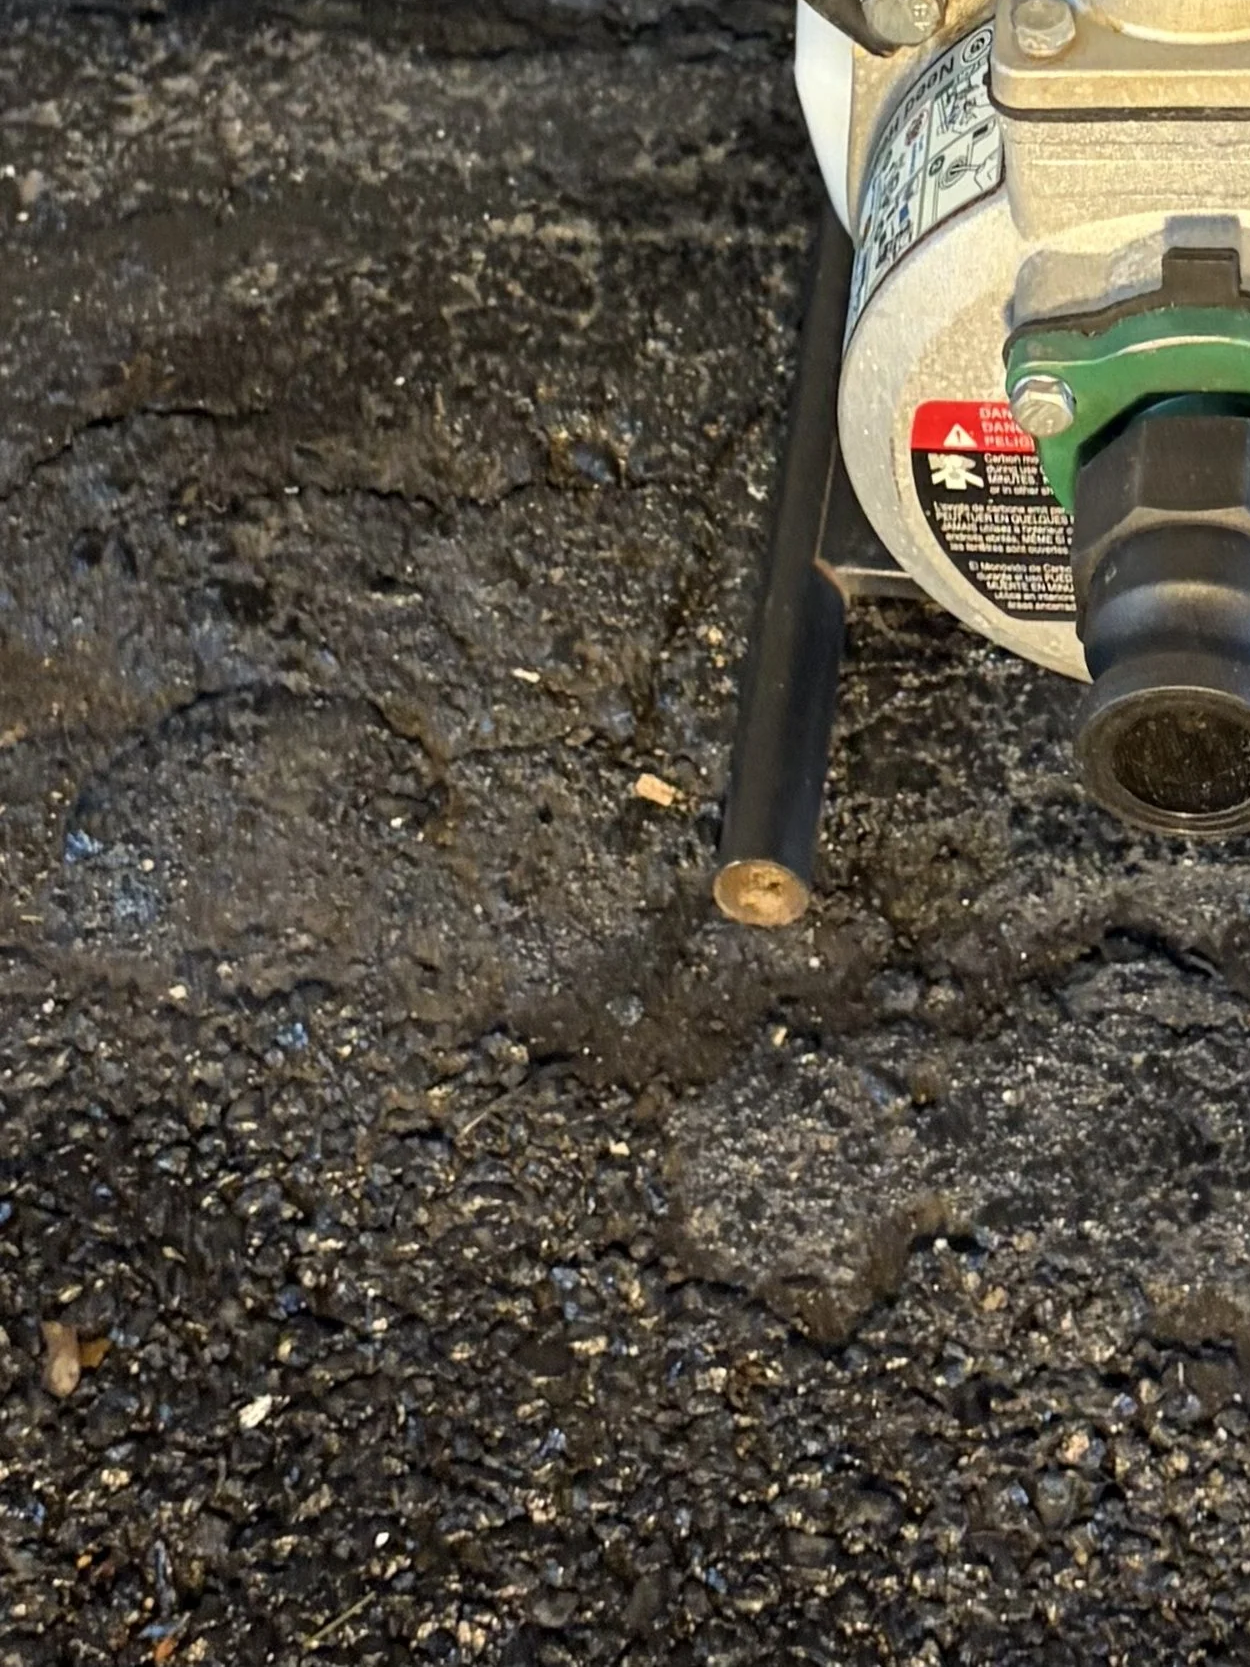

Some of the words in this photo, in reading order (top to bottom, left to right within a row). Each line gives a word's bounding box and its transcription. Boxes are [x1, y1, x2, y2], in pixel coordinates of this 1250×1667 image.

[979, 407, 1013, 420] DAN
[981, 421, 1023, 433] DAN
[984, 435, 1031, 448] PELIG
[984, 453, 1021, 465] Carbon
[1002, 485, 1012, 495] in
[1043, 563, 1072, 573] Carbo
[1044, 573, 1073, 583] PUED
[1047, 583, 1074, 593] MINU
